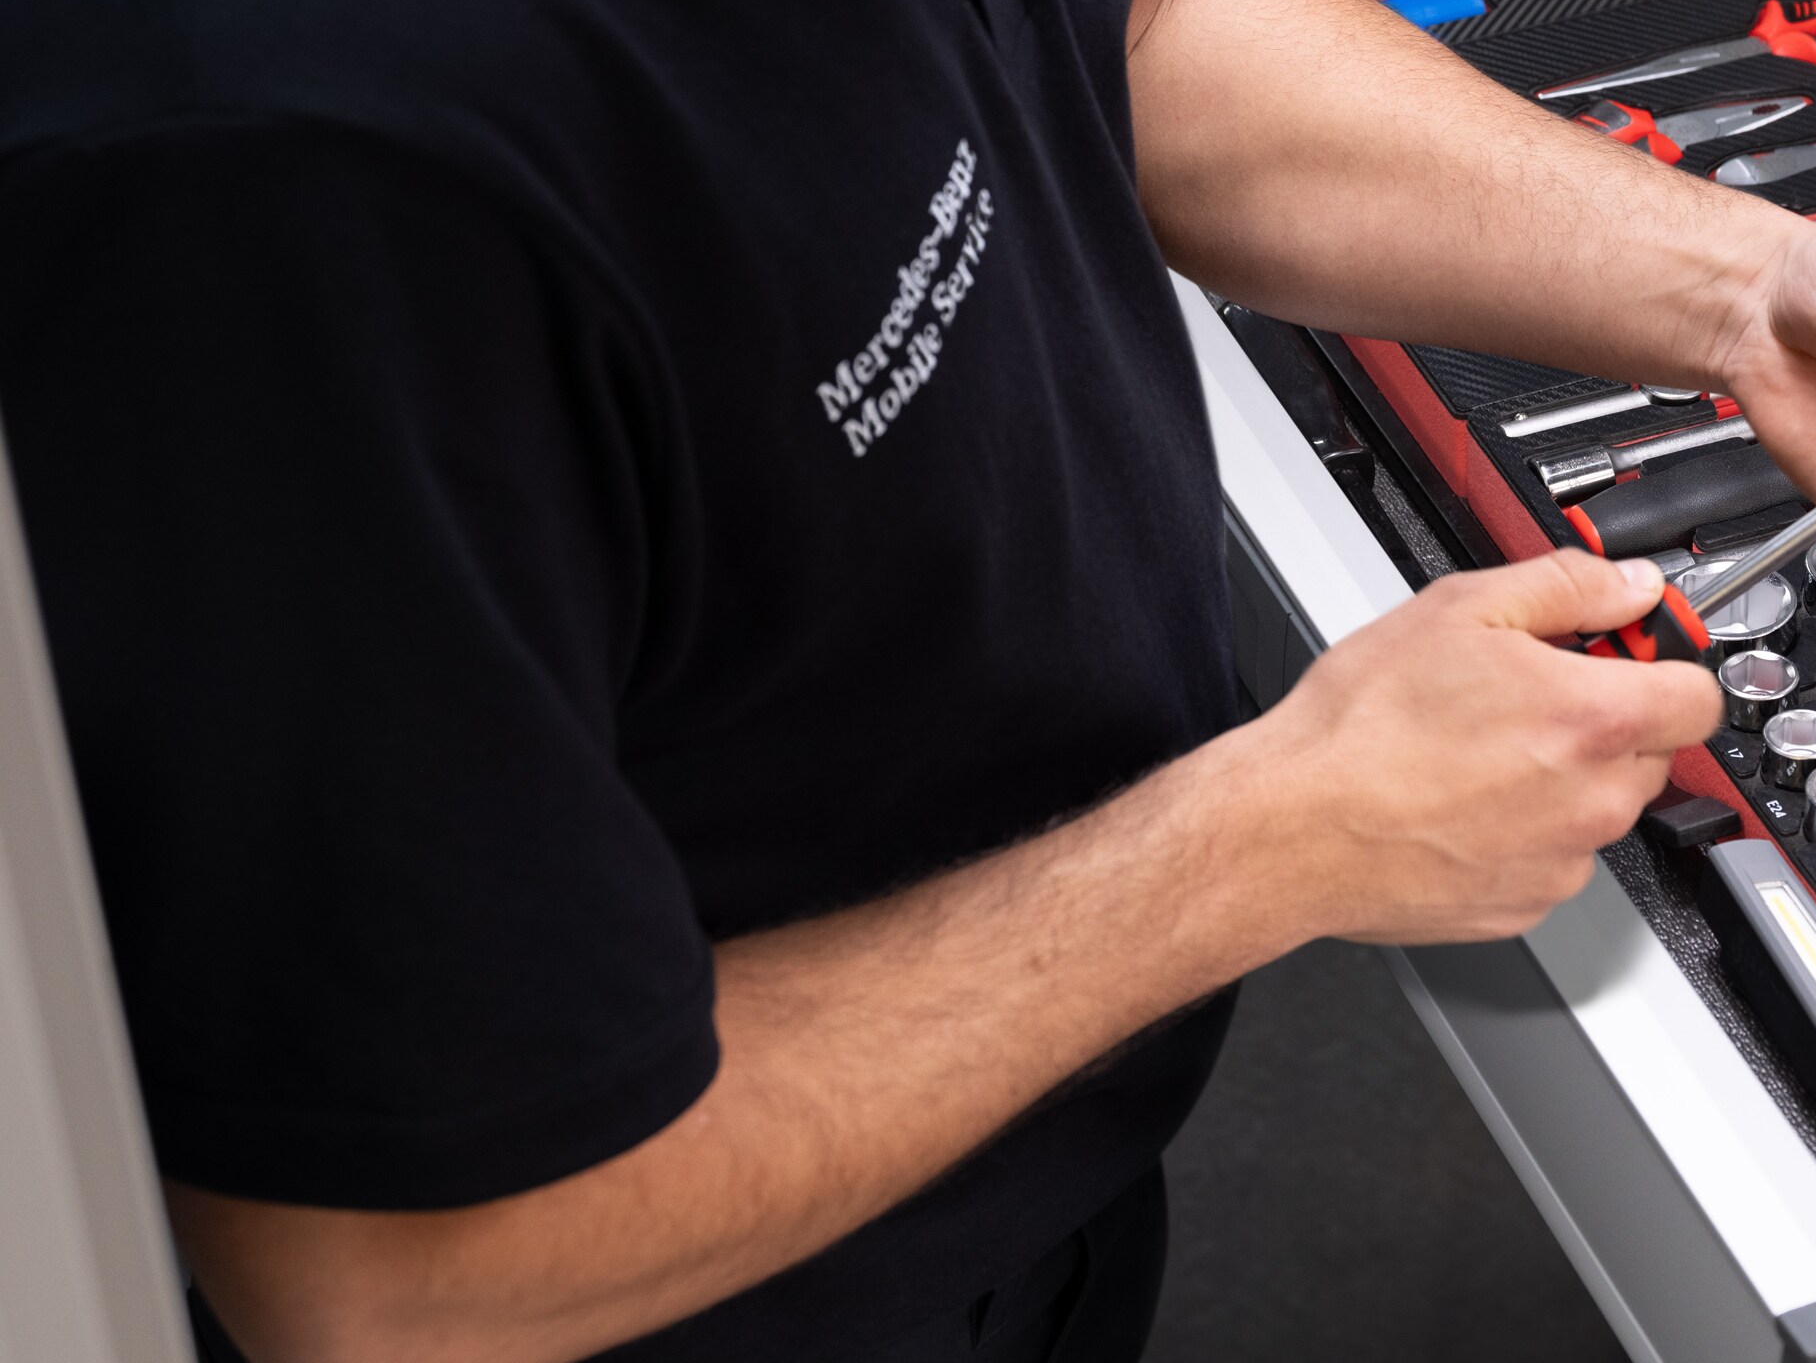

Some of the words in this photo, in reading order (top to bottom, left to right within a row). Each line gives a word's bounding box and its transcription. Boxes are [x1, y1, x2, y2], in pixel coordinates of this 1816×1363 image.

[816, 137, 977, 423] Mercedes-Benz
[842, 323, 943, 458] Mobile
[1727, 747, 1744, 759] 17
[1766, 799, 1787, 819] E24
